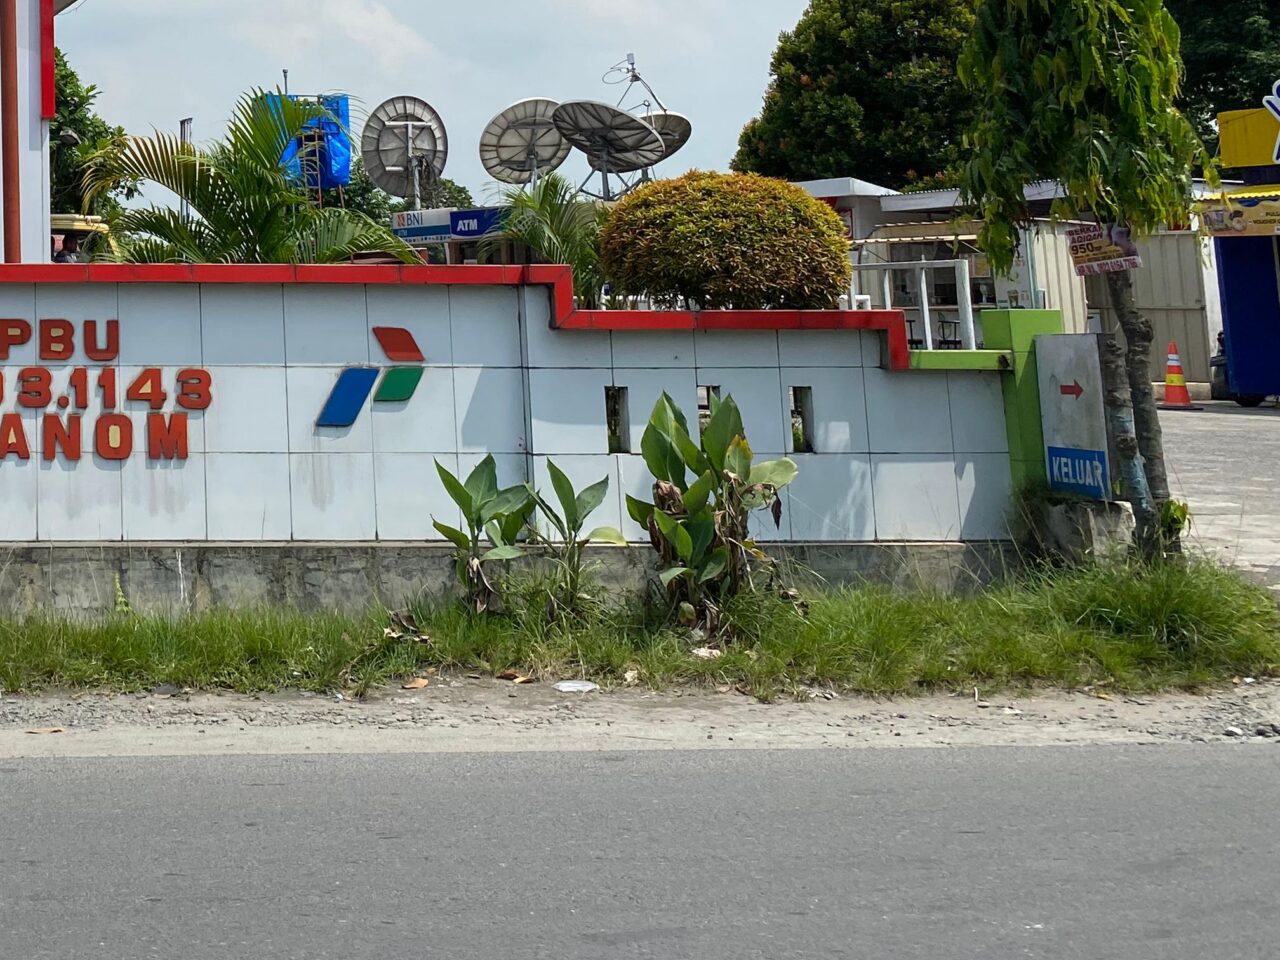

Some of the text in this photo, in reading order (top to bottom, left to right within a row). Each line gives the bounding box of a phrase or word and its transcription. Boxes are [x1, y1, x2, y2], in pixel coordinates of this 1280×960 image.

[407, 212, 423, 226] BNI
[456, 218, 478, 232] ATM
[1071, 242, 1094, 255] 950
[1052, 456, 1103, 487] KELUAR
